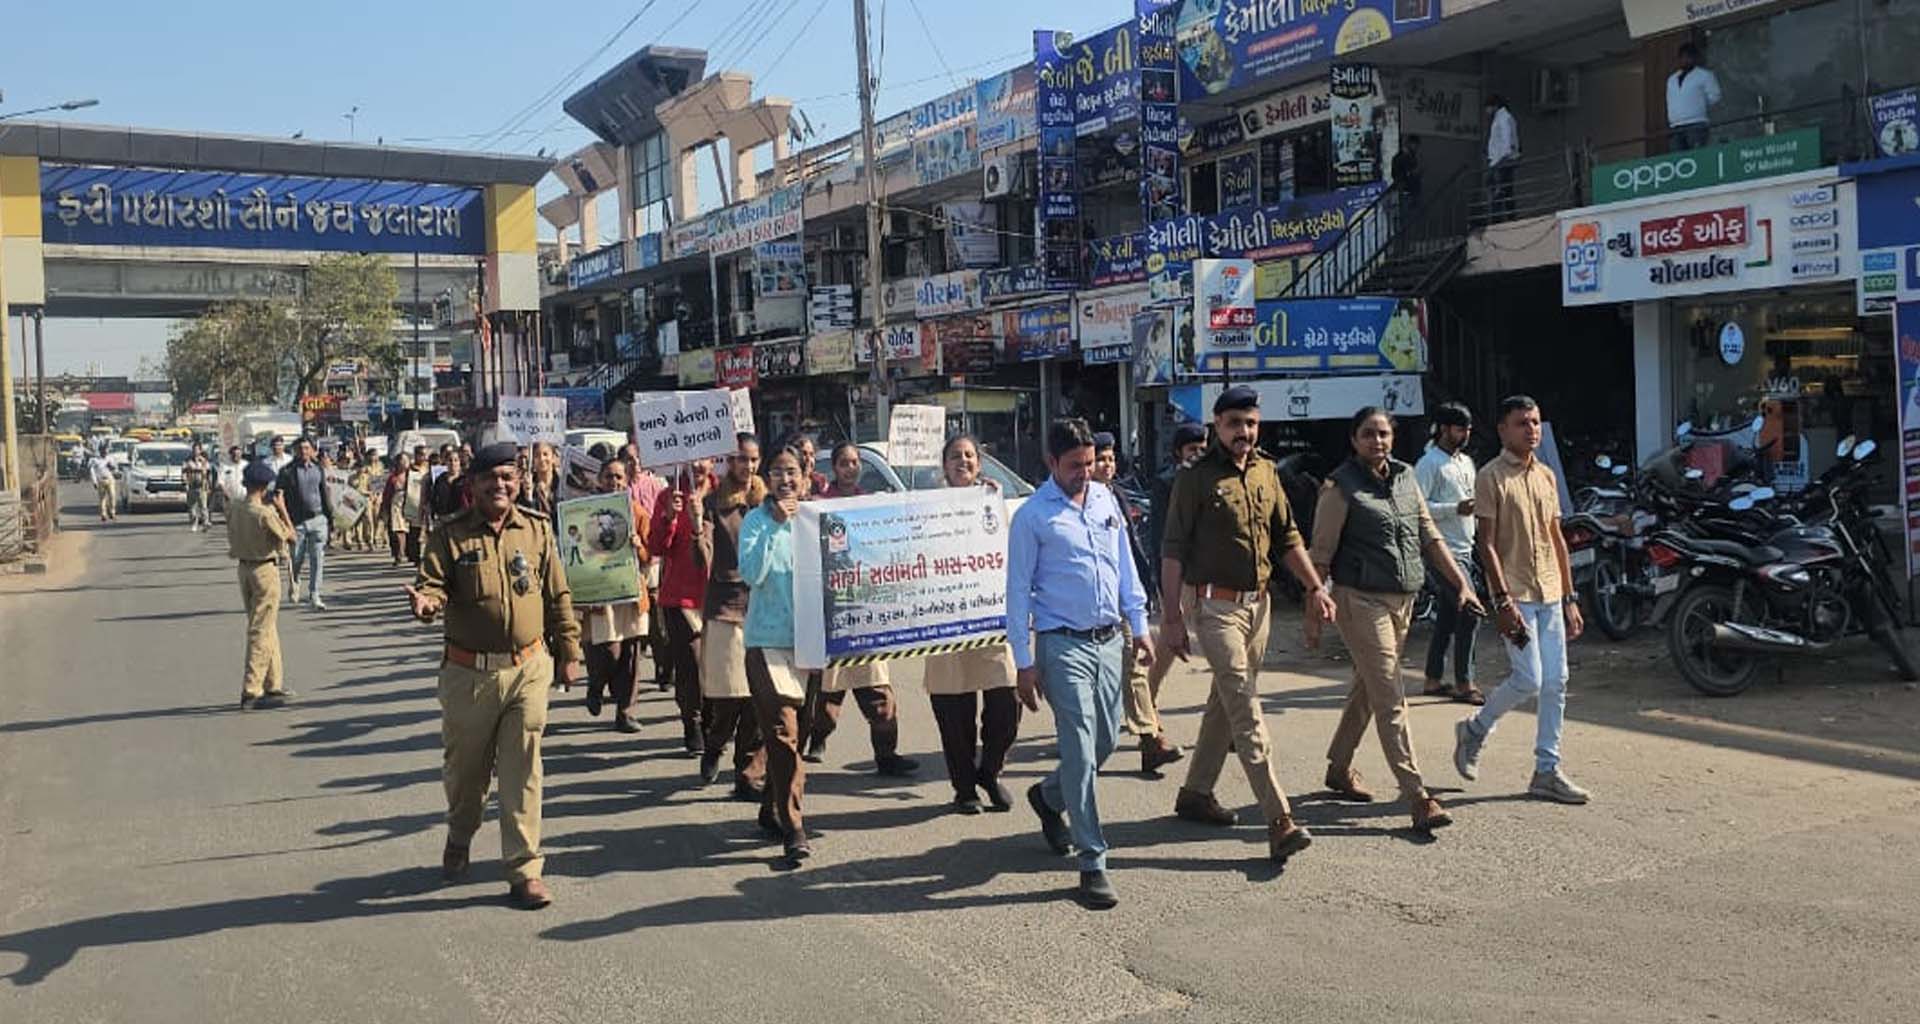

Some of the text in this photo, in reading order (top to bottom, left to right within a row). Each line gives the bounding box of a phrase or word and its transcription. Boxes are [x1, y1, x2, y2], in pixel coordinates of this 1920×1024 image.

[1613, 158, 1698, 192] oppo
[58, 183, 461, 238] ફરી પધારશો સૌને જય જલારામ
[1792, 191, 1829, 204] vivo
[1208, 210, 1269, 253] ફેમીલી
[1790, 213, 1831, 226] oppo
[1304, 326, 1328, 349] ફોટો
[640, 413, 667, 431] આજે
[716, 403, 729, 418] તો
[829, 559, 861, 589] માર્ગ
[870, 553, 928, 585] સલામતી
